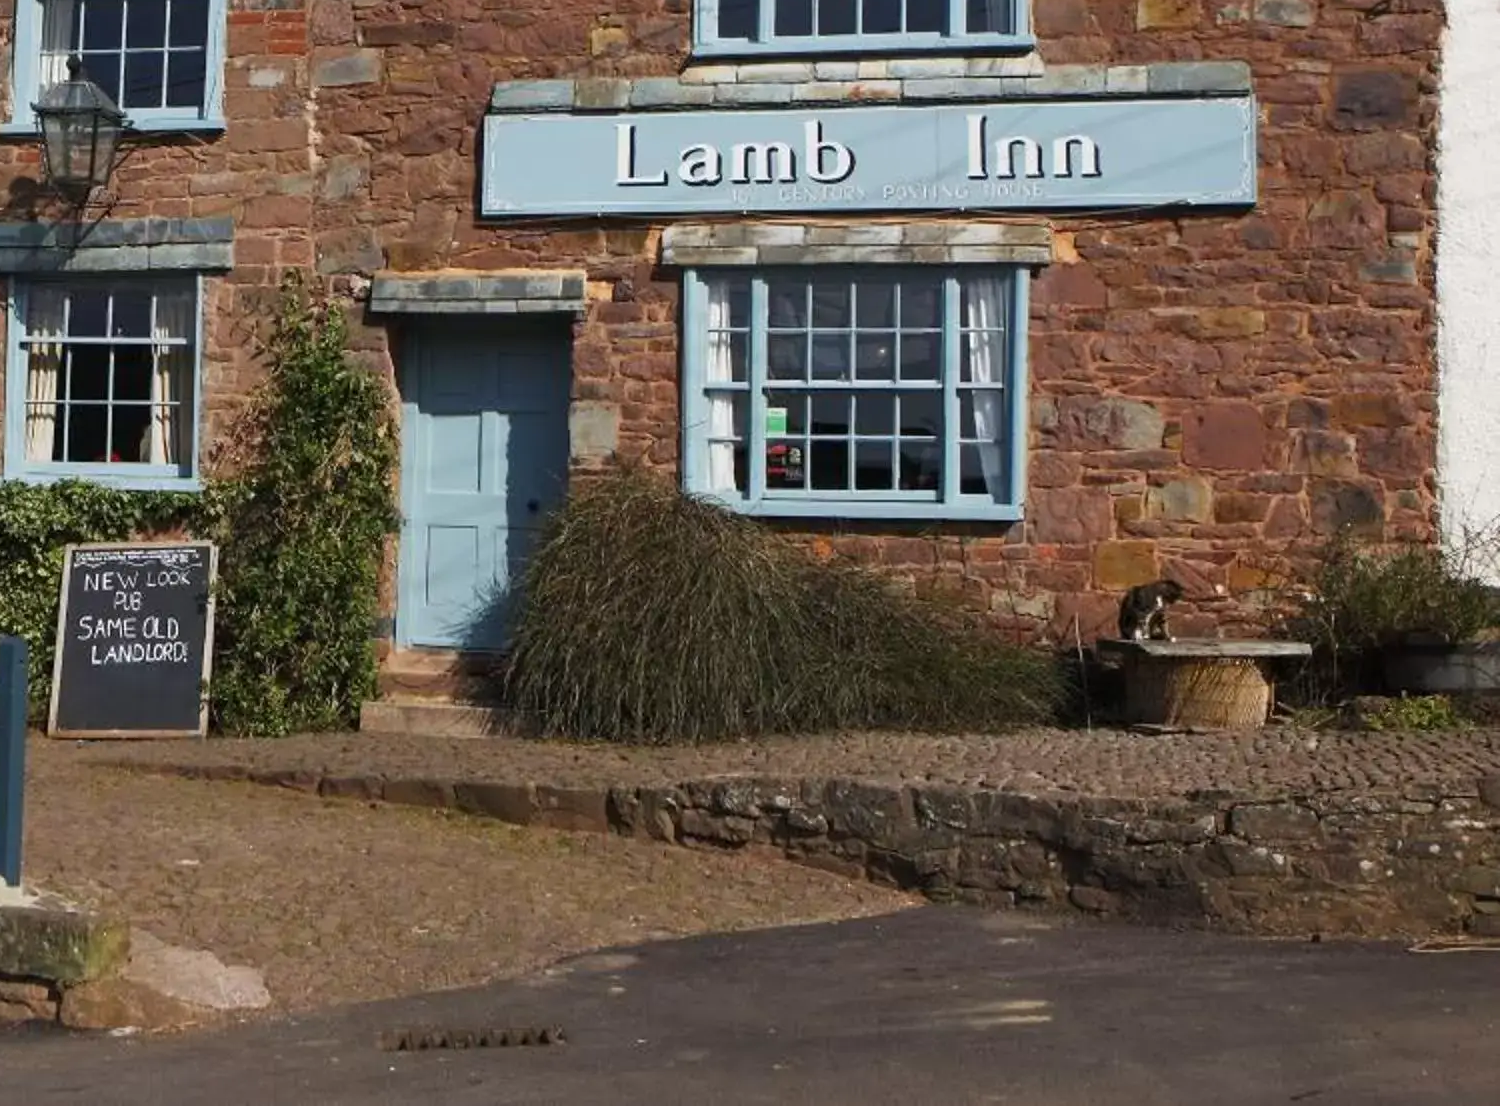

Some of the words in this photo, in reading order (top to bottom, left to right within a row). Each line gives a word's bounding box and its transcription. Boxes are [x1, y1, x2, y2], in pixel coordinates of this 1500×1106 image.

[614, 120, 856, 187] Lamb
[966, 114, 1101, 180] Inn
[883, 183, 969, 202] POSTING
[980, 180, 1044, 200] HOUSE
[83, 571, 139, 591] NEW
[146, 570, 191, 587] LOOK
[113, 590, 143, 611] PUB
[77, 615, 137, 641] SAME
[142, 615, 179, 640] OLD
[91, 641, 189, 666] LANDLORD!
